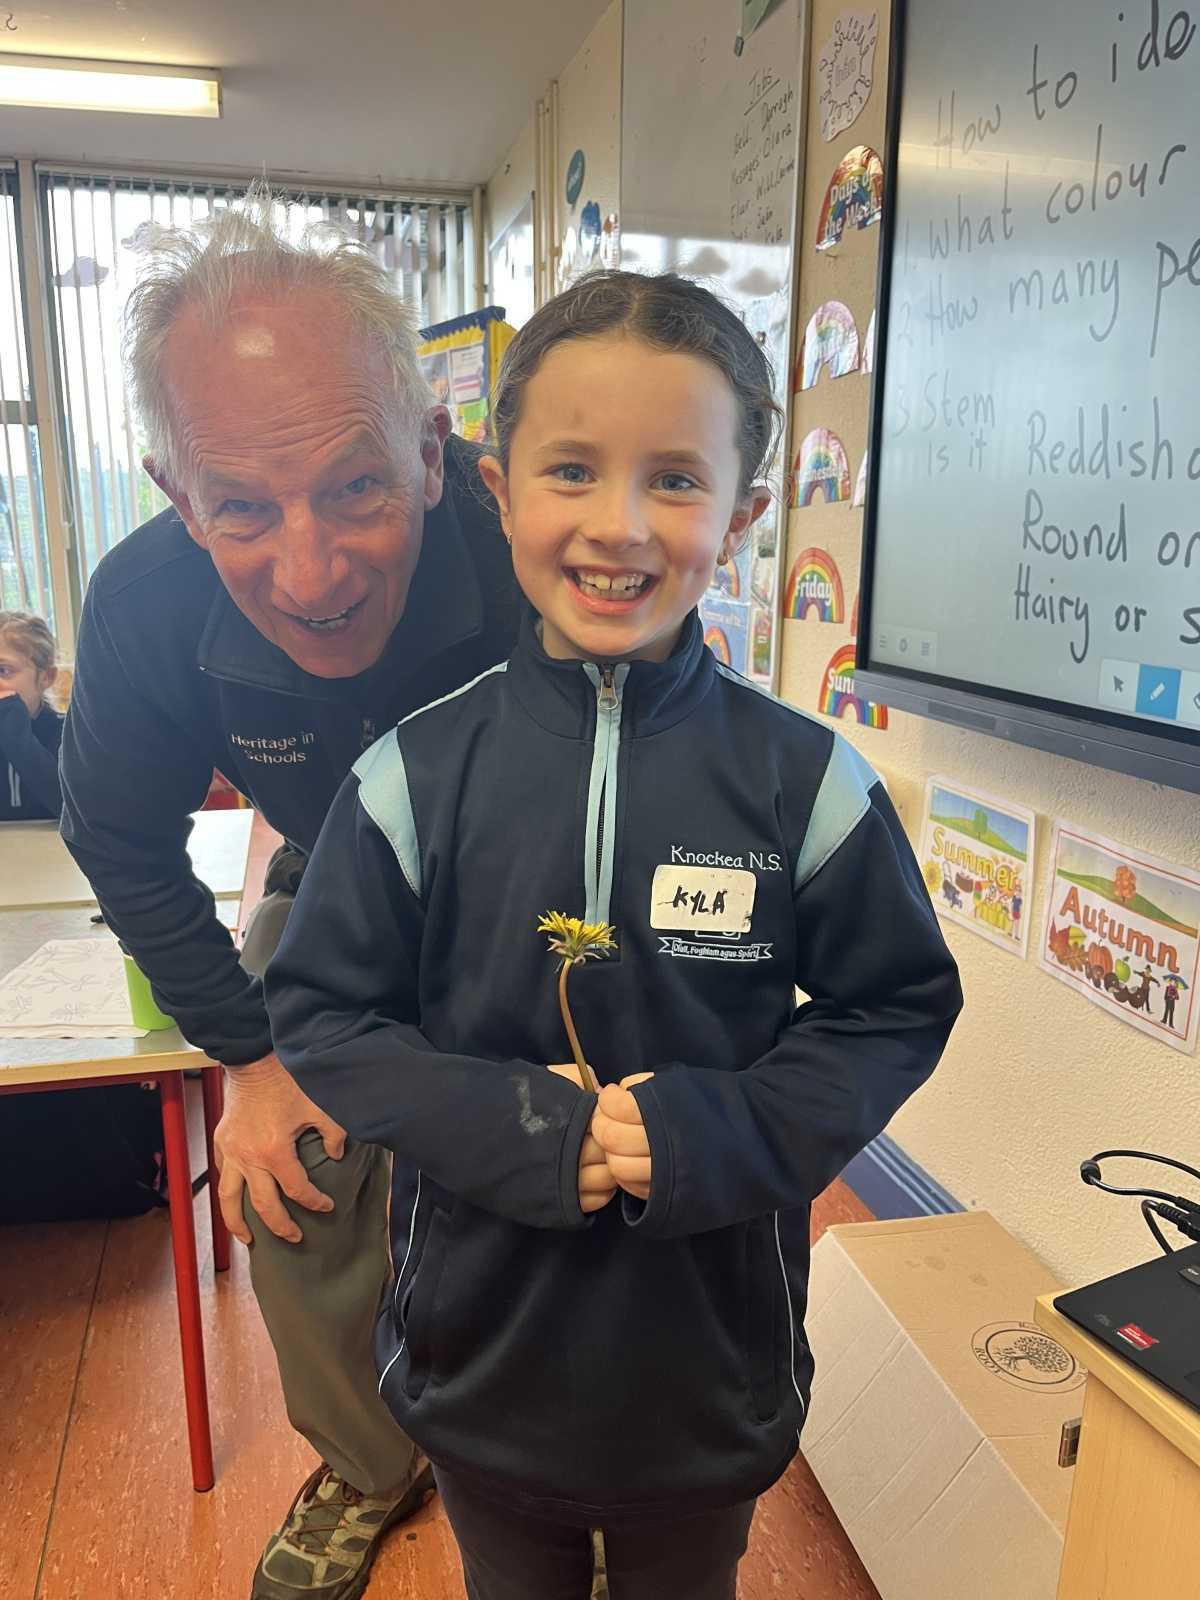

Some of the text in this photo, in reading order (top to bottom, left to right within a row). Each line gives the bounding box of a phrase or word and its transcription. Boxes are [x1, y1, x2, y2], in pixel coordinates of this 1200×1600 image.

[932, 89, 1001, 169] How
[1026, 43, 1078, 121] to
[1046, 124, 1188, 224] colour
[924, 272, 979, 347] How
[1009, 259, 1120, 342] many
[921, 368, 995, 432] Stem
[968, 427, 988, 473] it
[1026, 395, 1174, 480] Reddish
[1022, 488, 1128, 562] Round
[795, 574, 833, 606] Friday
[1013, 562, 1091, 664] Hairy
[1115, 604, 1148, 633] or
[231, 730, 314, 750] Heritage in
[244, 749, 307, 764] Schools
[671, 845, 783, 871] Knockea N.S.
[931, 826, 1020, 892] Summer
[1059, 886, 1180, 974] Autumn
